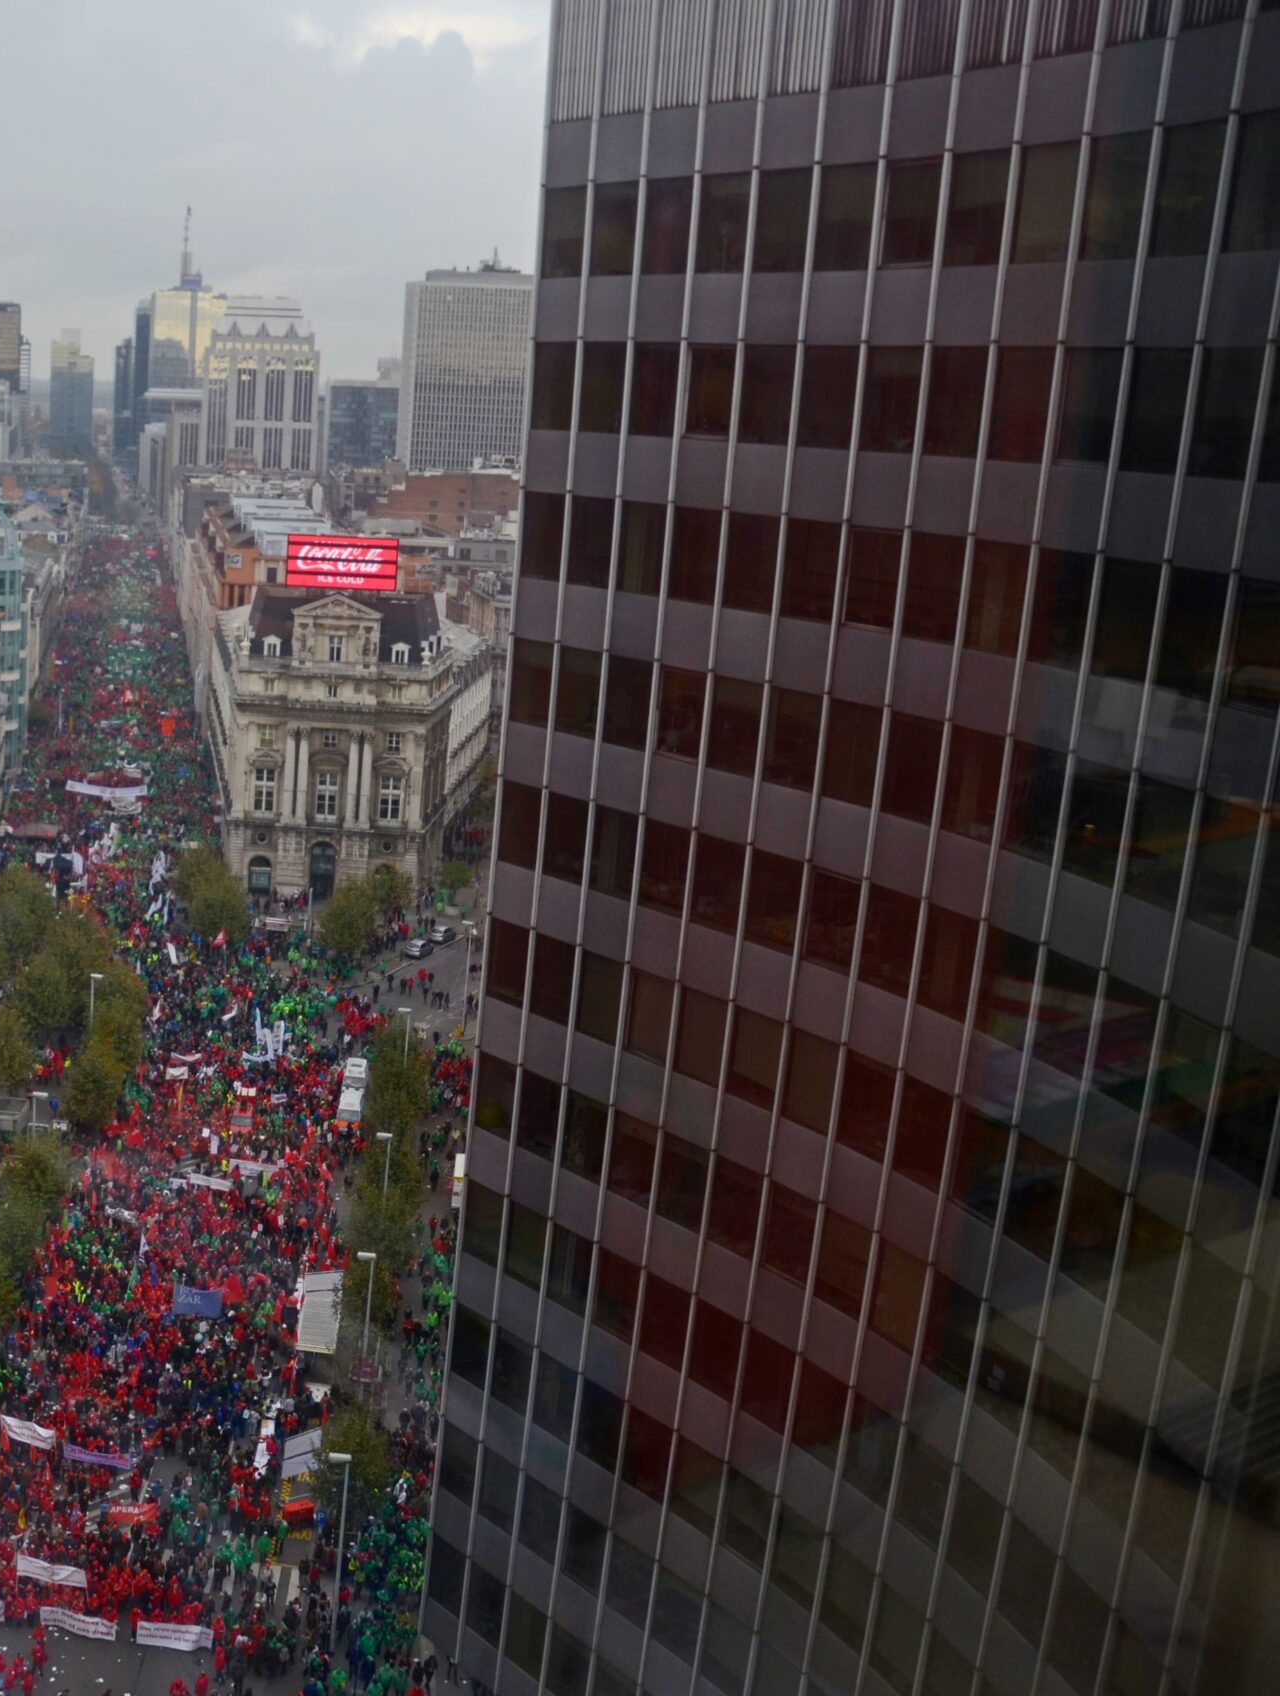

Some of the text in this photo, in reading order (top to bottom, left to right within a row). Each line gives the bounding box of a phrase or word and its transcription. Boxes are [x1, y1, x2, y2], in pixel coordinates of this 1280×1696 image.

[297, 545, 383, 573] Coca-Cola
[178, 1294, 201, 1304] ZAR
[318, 1512, 324, 1521] P
